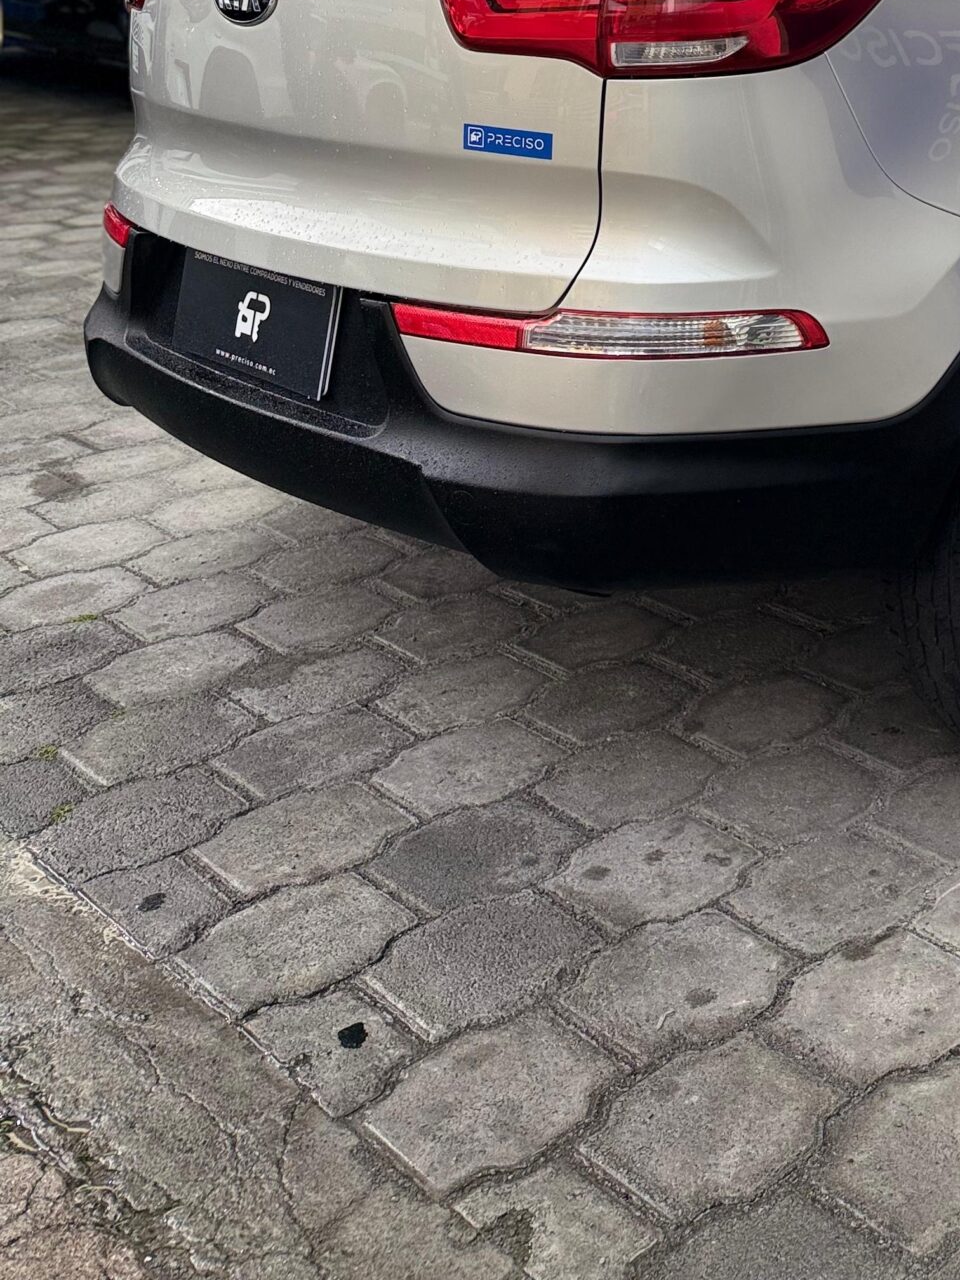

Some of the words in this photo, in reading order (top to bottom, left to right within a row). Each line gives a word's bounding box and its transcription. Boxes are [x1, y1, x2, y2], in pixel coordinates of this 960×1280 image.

[487, 132, 545, 151] PRECISO
[194, 251, 213, 263] SOMOS
[220, 257, 234, 269] NEXO
[234, 262, 250, 274] ENTRE
[250, 267, 288, 285] COMPRADORES
[292, 279, 326, 297] VENDEDORES
[215, 348, 276, 376] www.preciso.com.ec
